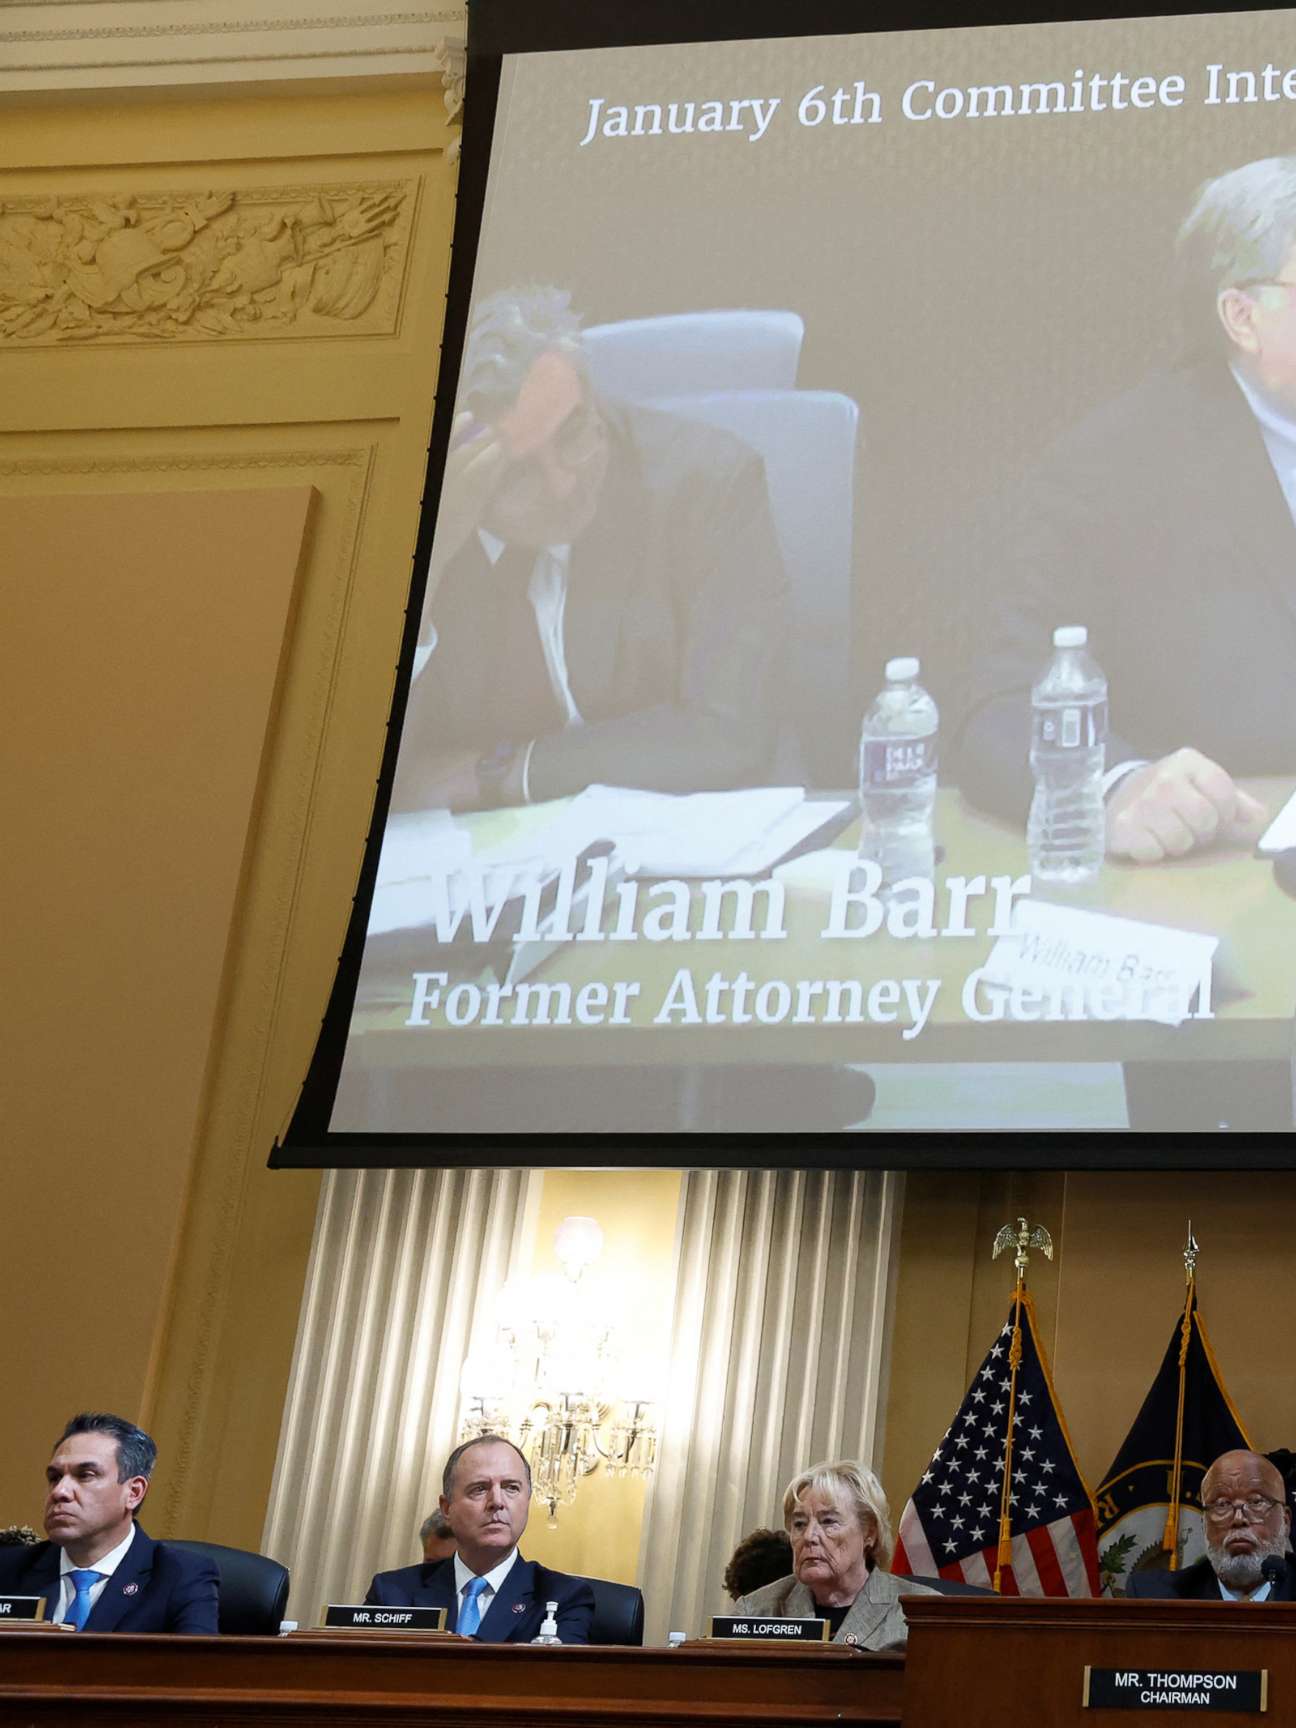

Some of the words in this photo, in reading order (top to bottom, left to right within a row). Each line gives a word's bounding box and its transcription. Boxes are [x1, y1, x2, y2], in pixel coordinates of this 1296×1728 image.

[580, 98, 781, 146] January
[797, 80, 882, 127] 6th
[900, 69, 1186, 120] Committee
[429, 854, 789, 944] William
[820, 857, 1032, 939] Barr
[1018, 932, 1110, 977] William
[404, 970, 641, 1027] Former
[653, 968, 942, 1041] Attorney
[961, 958, 1216, 1022] General
[353, 1613, 372, 1623] MR.
[374, 1613, 413, 1624] SCHIFF
[732, 1623, 751, 1634] MS.
[753, 1624, 802, 1635] LOFGREN
[1114, 1672, 1143, 1688] MR.
[1147, 1673, 1237, 1690] THOMPSON
[1140, 1690, 1210, 1705] CHAIRMAN
